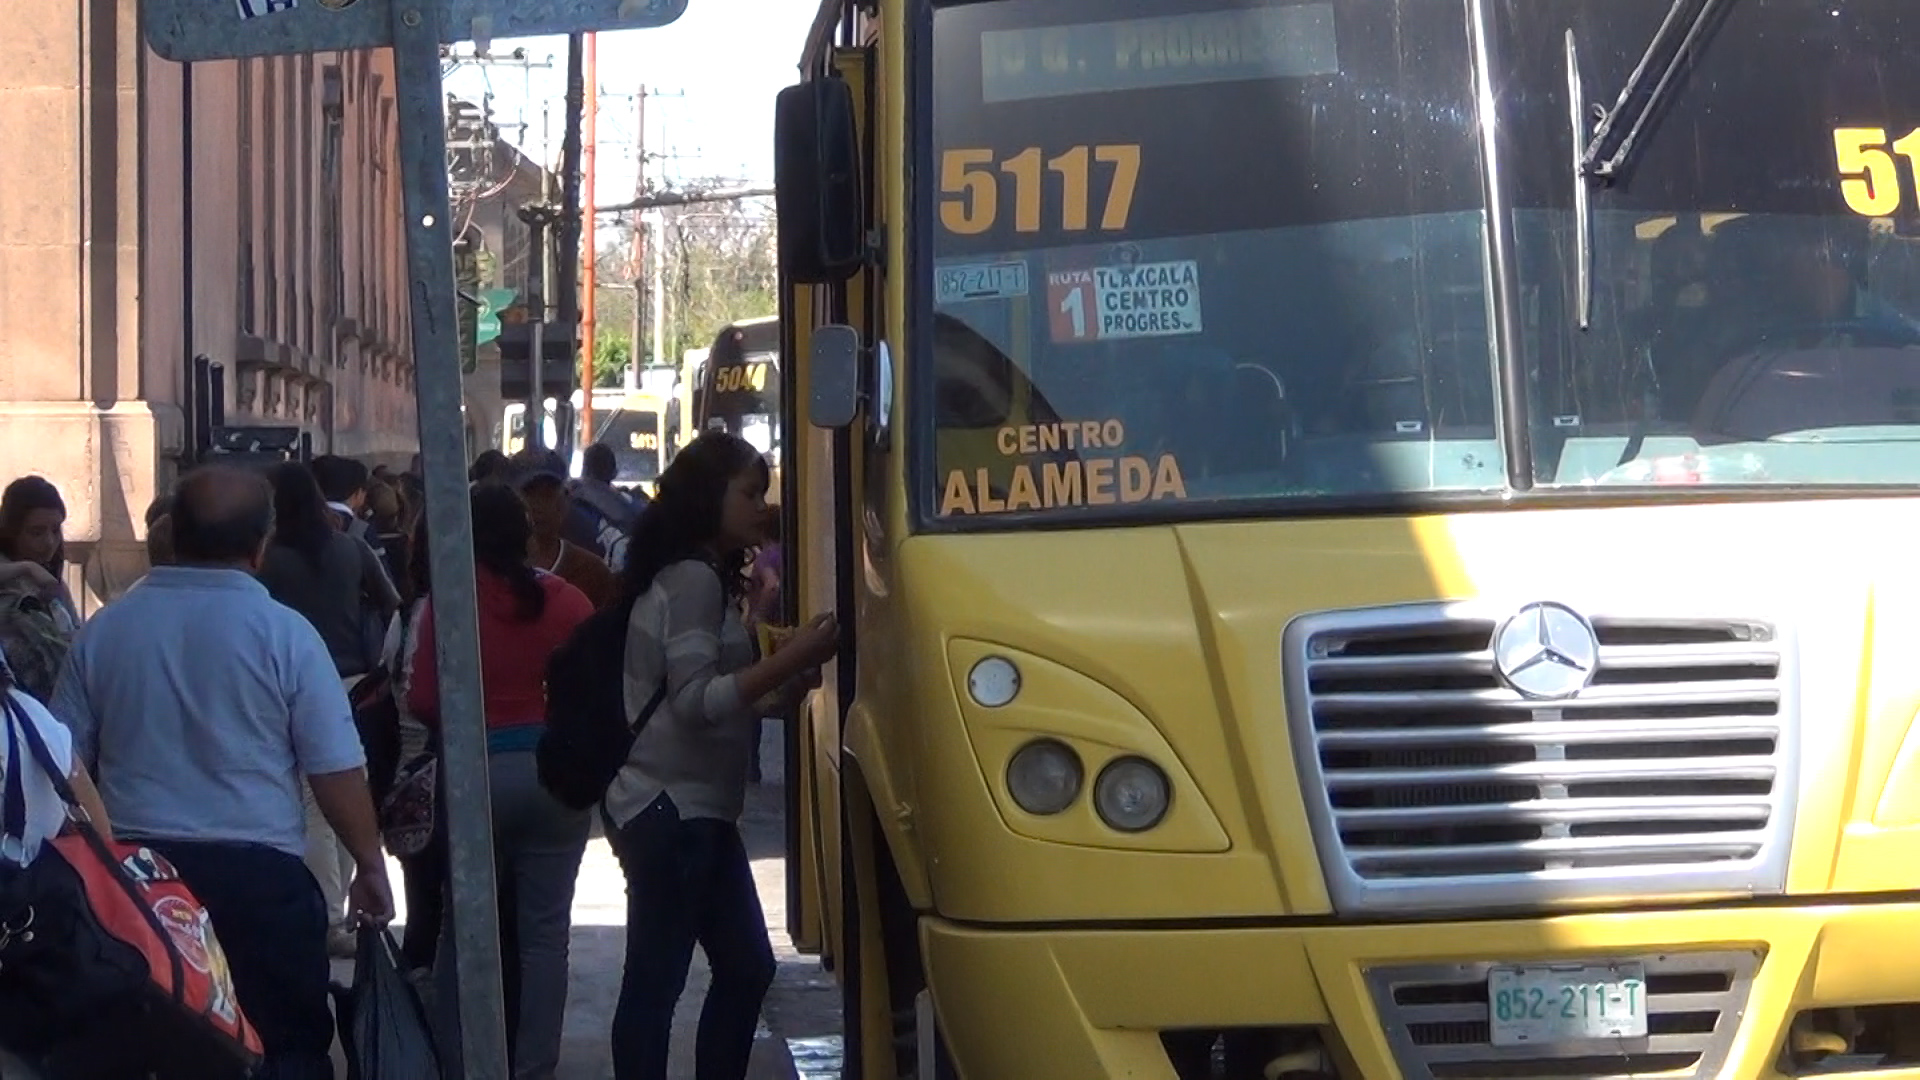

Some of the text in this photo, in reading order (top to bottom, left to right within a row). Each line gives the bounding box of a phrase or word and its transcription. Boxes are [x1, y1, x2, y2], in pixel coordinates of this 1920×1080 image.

[940, 145, 1141, 235] 5117
[1049, 272, 1092, 285] RUTA
[1097, 265, 1195, 289] TLAXCALA
[1061, 287, 1085, 339] 1
[1105, 288, 1189, 311] CENTRO
[997, 418, 1124, 455] CENTRO
[940, 453, 1188, 516] ALAMEDA
[1496, 979, 1640, 1022] 852-211-T
